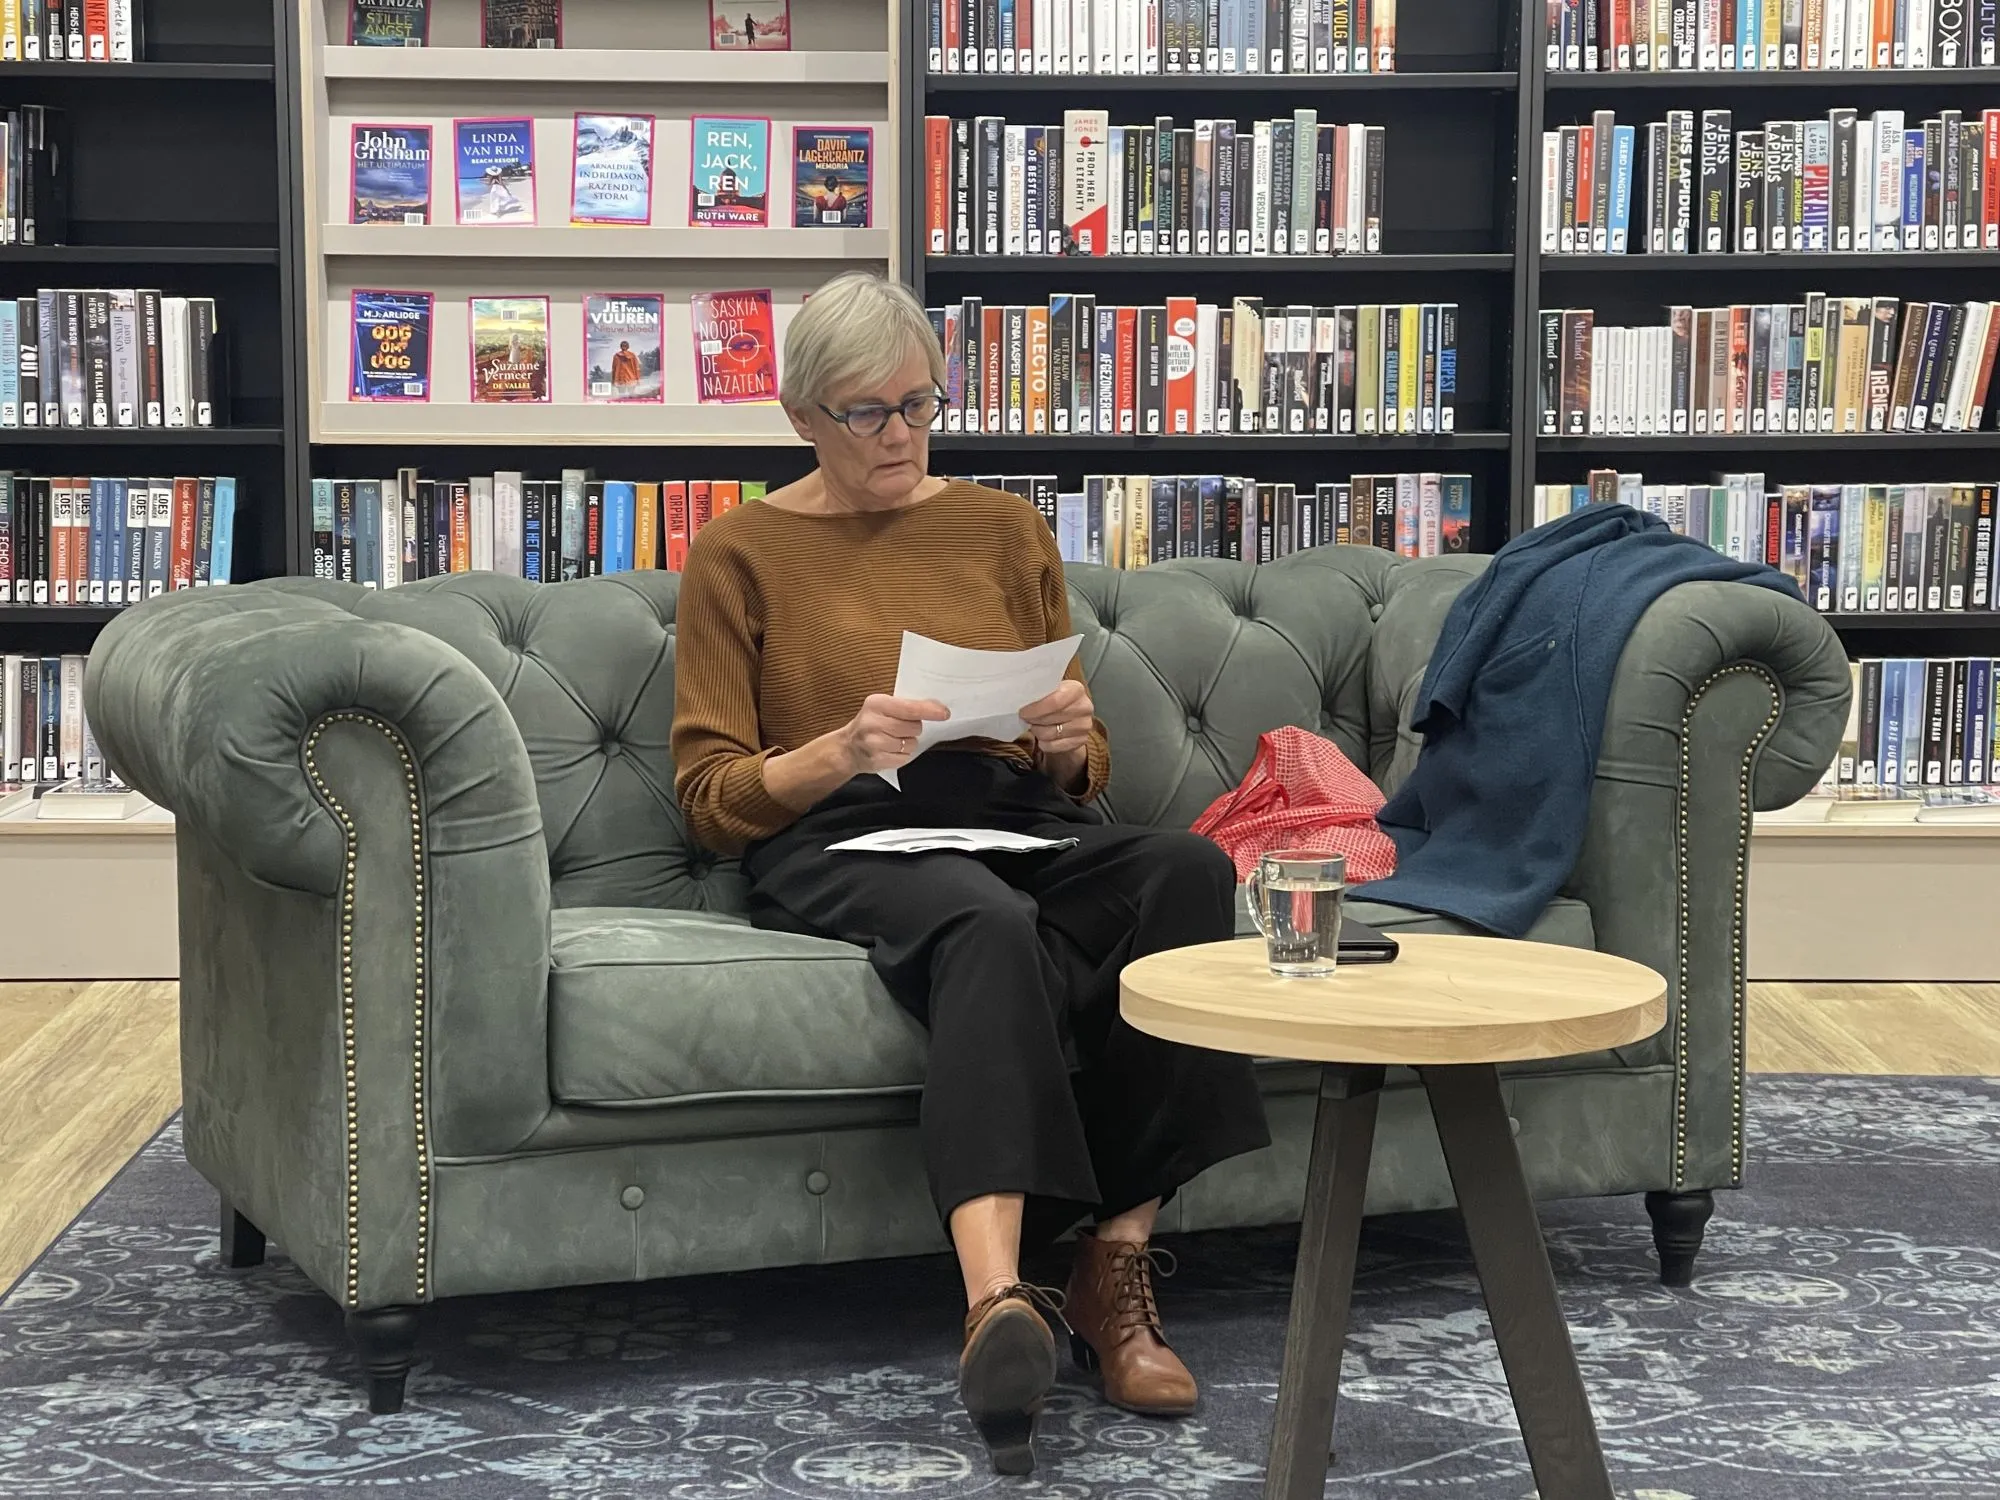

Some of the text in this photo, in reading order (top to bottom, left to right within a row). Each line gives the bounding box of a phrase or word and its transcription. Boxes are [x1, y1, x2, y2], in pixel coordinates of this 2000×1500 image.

[364, 26, 413, 38] ANGST
[366, 12, 413, 26] STILLE
[354, 142, 430, 161] Grisham
[362, 131, 407, 150] John
[464, 145, 524, 156] VAN RIJN
[472, 134, 517, 144] LINDA
[707, 132, 753, 149] REN,
[817, 139, 847, 151] DAVID
[1703, 113, 1717, 175] LAPIDUS
[1717, 125, 1730, 164] JENS
[1808, 127, 1818, 165] LAPIDUS
[1819, 135, 1827, 157] JENS
[1881, 121, 1891, 153] LARSSON
[357, 161, 425, 170] HET ULTIMATUM
[590, 163, 635, 171] ARNALDUR
[701, 154, 758, 171] JACK,
[799, 150, 865, 163] LAGERCRANTZ
[815, 162, 849, 170] MEMORIA
[1028, 149, 1037, 162] DE
[1299, 121, 1313, 207] Menno Kalmann
[1739, 132, 1751, 189] LAPIDUS
[1751, 142, 1764, 179] JENS
[1767, 124, 1781, 183] LAPIDUS
[1781, 135, 1793, 172] JENS
[579, 171, 644, 181] INDRIDASON
[709, 175, 748, 191] REN
[1028, 165, 1037, 195] BESTE
[1049, 149, 1057, 220] DE VERLOREN DOCHTER
[1076, 152, 1085, 212] TO ETERNITY
[1087, 151, 1096, 203] FROM HERE
[1616, 136, 1629, 219] TJEERD LANGSTRAAT
[1678, 113, 1695, 229] JENS LAPIDUS
[1794, 124, 1803, 223] JENS LAPIDUS SNOEIHARD
[1879, 161, 1890, 205] ONZE VADERS
[588, 182, 636, 192] RAZENDE
[593, 192, 628, 201] STORM
[697, 211, 759, 222] RUTH WARE
[1709, 190, 1722, 222] Topman
[68, 295, 78, 346] DAVID HEWSON
[88, 297, 98, 329] HEWSON
[97, 302, 106, 324] DAVID
[145, 295, 157, 346] DAVID HEWSON
[198, 306, 206, 328] SARAH
[384, 311, 420, 320] ARLIDGE
[590, 313, 658, 324] VUUREN
[602, 302, 627, 313] JET
[710, 297, 758, 318] SASKIA
[113, 316, 125, 352] HEWSON
[124, 324, 132, 344] DAVID
[594, 324, 654, 333] Nieuw bloed
[699, 319, 745, 340] NOORT
[1546, 315, 1559, 359] Midland
[1574, 320, 1586, 360] Midland
[1734, 322, 1745, 345] LEE
[1908, 309, 1923, 358] DONNA LEON
[1947, 309, 1963, 357] DONNA LEON
[4, 319, 15, 395] ANNETTE HESS DE TOLK
[20, 344, 38, 379] ZOUT
[491, 359, 540, 374] Suzanne
[702, 355, 718, 375] DE
[1032, 320, 1048, 392] ALECTO
[1061, 338, 1070, 381] HET BLAUW
[1122, 333, 1132, 408] ZEVEN LEUGENS
[1441, 349, 1457, 393] VERPEST
[482, 367, 532, 384] Vermeer
[704, 372, 765, 396] NAZATEN
[1770, 370, 1785, 401] MAGMA
[60, 493, 71, 515] LOES
[136, 494, 147, 517] LOES
[158, 493, 169, 515] LOES
[723, 497, 731, 505] DE
[1047, 491, 1055, 516] LARS
[1135, 487, 1143, 530] PHILIP KERR
[1355, 495, 1365, 520] KING
[1376, 486, 1388, 516] KING
[1401, 479, 1413, 508] KING
[1424, 488, 1436, 517] KING
[1450, 484, 1459, 510] KING
[180, 484, 193, 550] Loes den Hollander
[200, 484, 213, 550] Loes den Hollander
[388, 494, 396, 552] LYDIA VAN HOUTEN
[455, 487, 465, 543] BLOEDHEET
[588, 495, 598, 555] DE NERGENSMAN
[641, 497, 650, 551] DE REKRUUT
[669, 495, 683, 531] ORPHAN
[1157, 500, 1169, 532] KERR
[1181, 500, 1192, 532] KERR
[1203, 499, 1215, 530] KERR
[1227, 501, 1237, 532] KERR
[1674, 495, 1684, 525] HANNA
[1731, 536, 1740, 552] DE
[1794, 513, 1803, 556] CHARLOTTE LINK
[131, 532, 143, 579] GENADEKLAP
[153, 531, 163, 570] PIJNGRENS
[438, 534, 448, 575] Portland
[1935, 678, 1943, 695] BLOED
[1955, 683, 1963, 733] UNDERCOVER
[1931, 717, 1942, 742] ZWAAN
